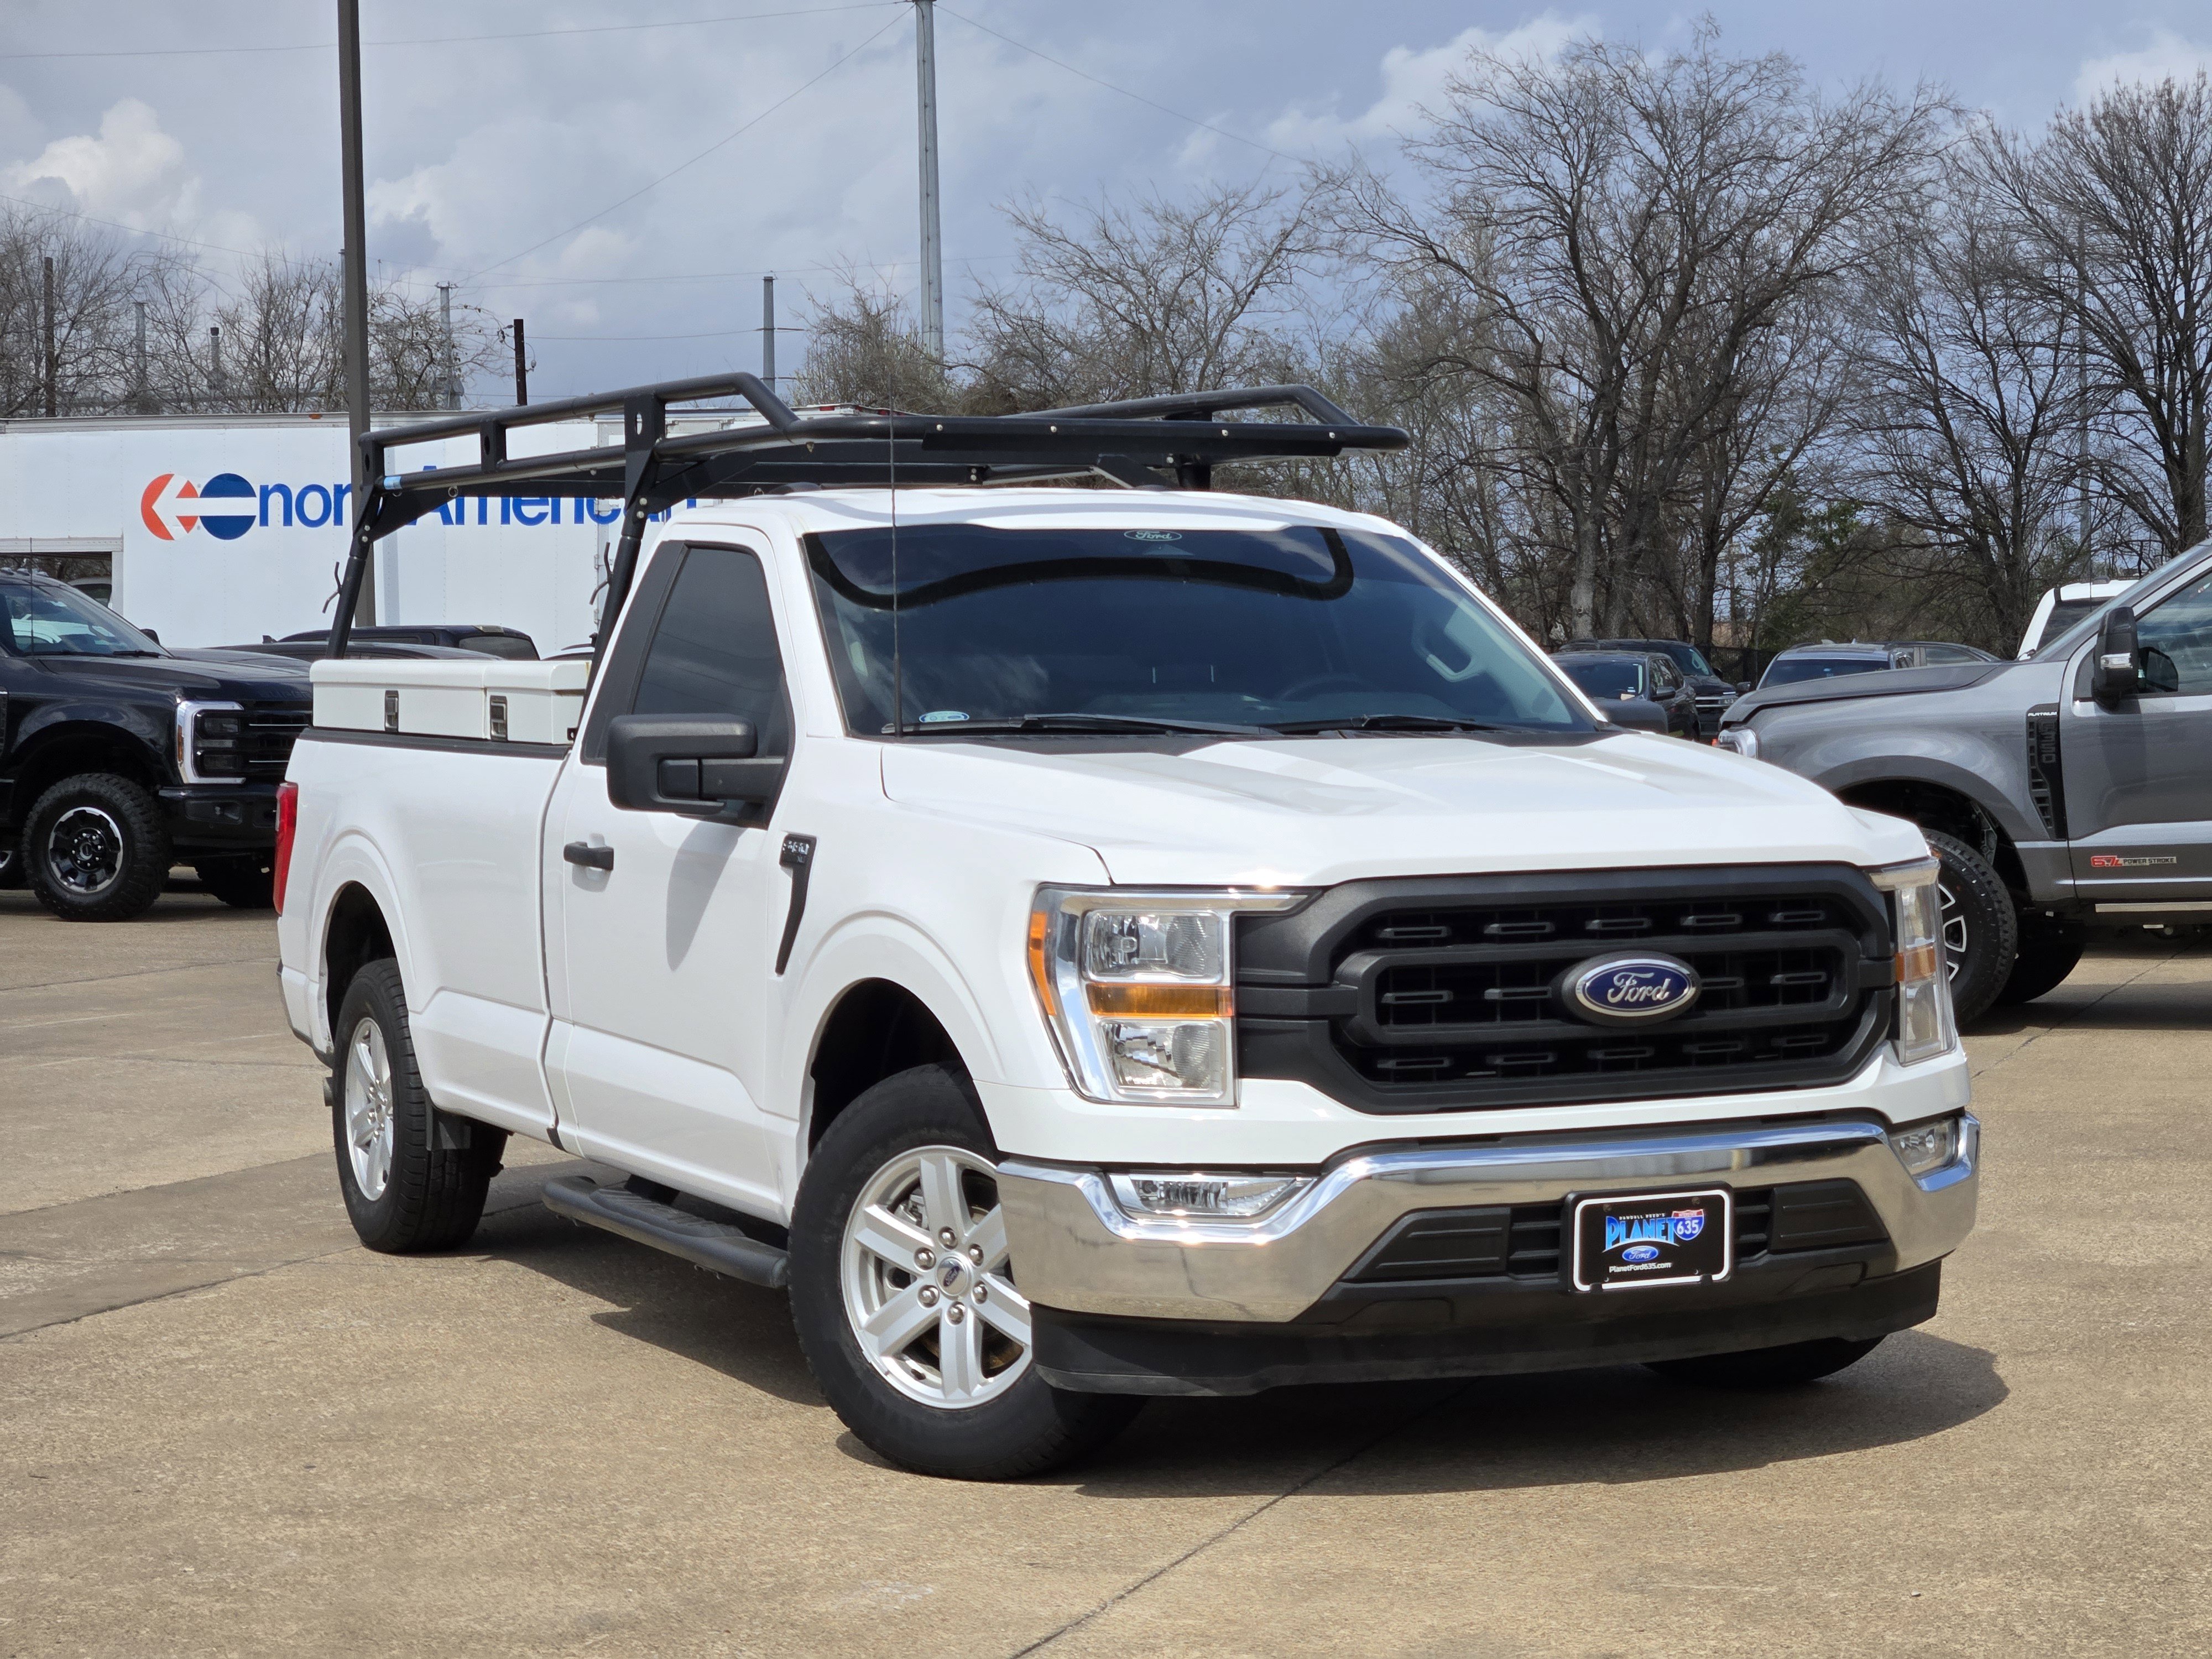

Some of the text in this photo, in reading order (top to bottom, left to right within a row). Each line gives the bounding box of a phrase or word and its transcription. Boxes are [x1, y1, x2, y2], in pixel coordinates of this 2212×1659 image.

[259, 465, 696, 528] nor Amerc
[1135, 531, 1172, 539] Ford
[1607, 972, 1671, 1003] Ford
[1605, 1215, 1677, 1251] PLANET
[1677, 1219, 1699, 1235] 635
[1628, 1249, 1651, 1260] Ford
[1609, 1262, 1672, 1273] PlanetFord635.com
